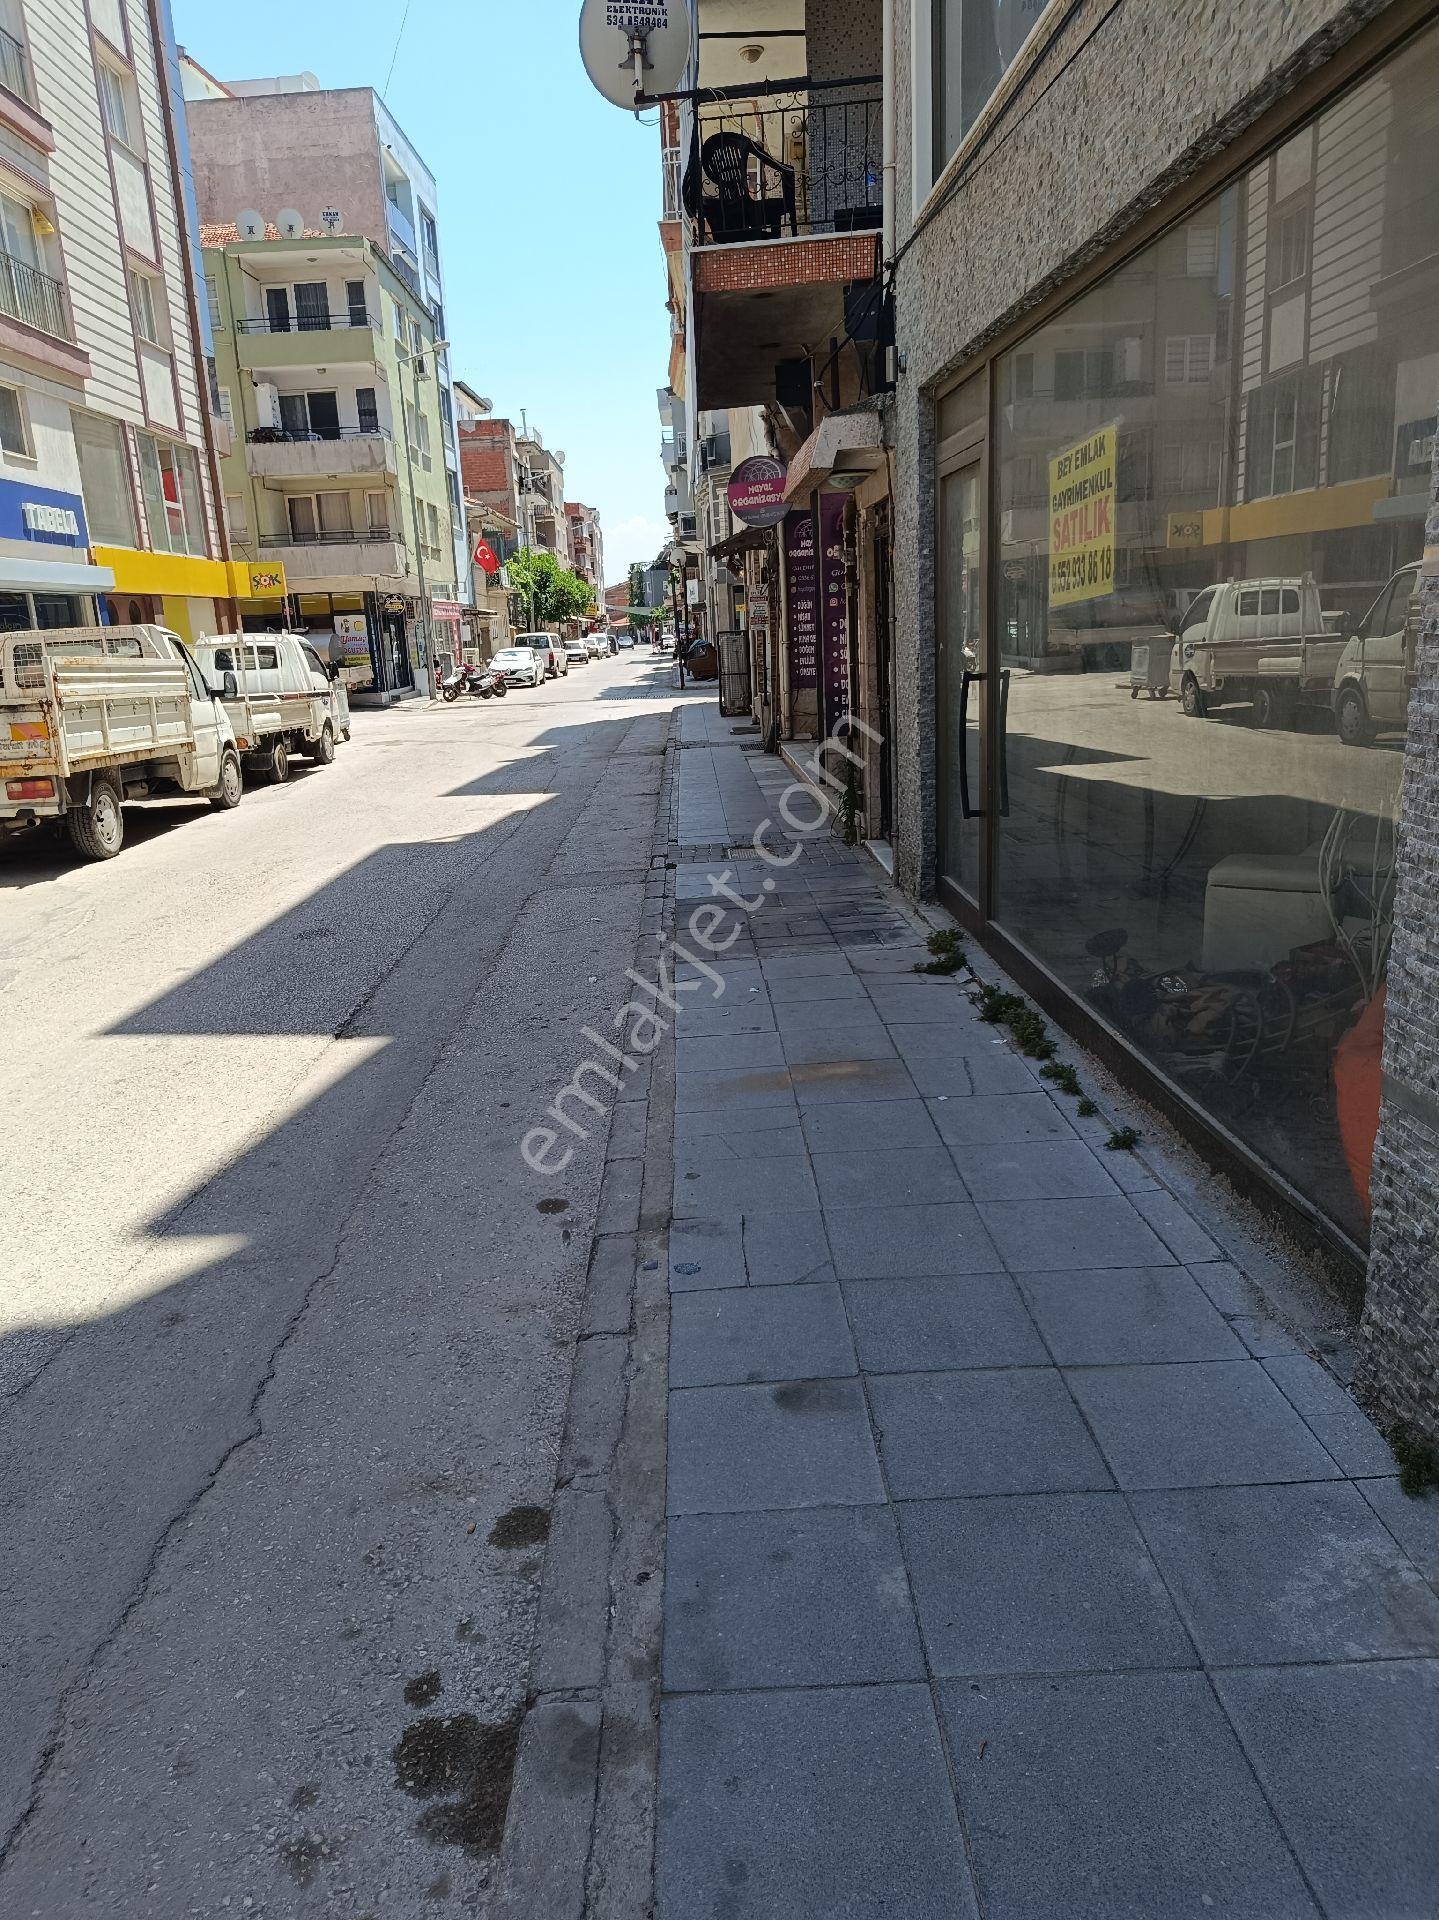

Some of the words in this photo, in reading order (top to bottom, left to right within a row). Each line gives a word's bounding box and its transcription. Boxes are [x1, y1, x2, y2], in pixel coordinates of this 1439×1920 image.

[606, 15, 624, 26] 534
[1057, 453, 1073, 480] BEY
[1074, 434, 1106, 470] EMLAK
[1052, 467, 1112, 512] GAYRİMENKUL
[1053, 494, 1111, 553] SATILIK
[252, 573, 282, 591] ŞOK
[1072, 554, 1086, 589] 933
[1088, 550, 1098, 585] 86
[1100, 544, 1112, 581] 18
